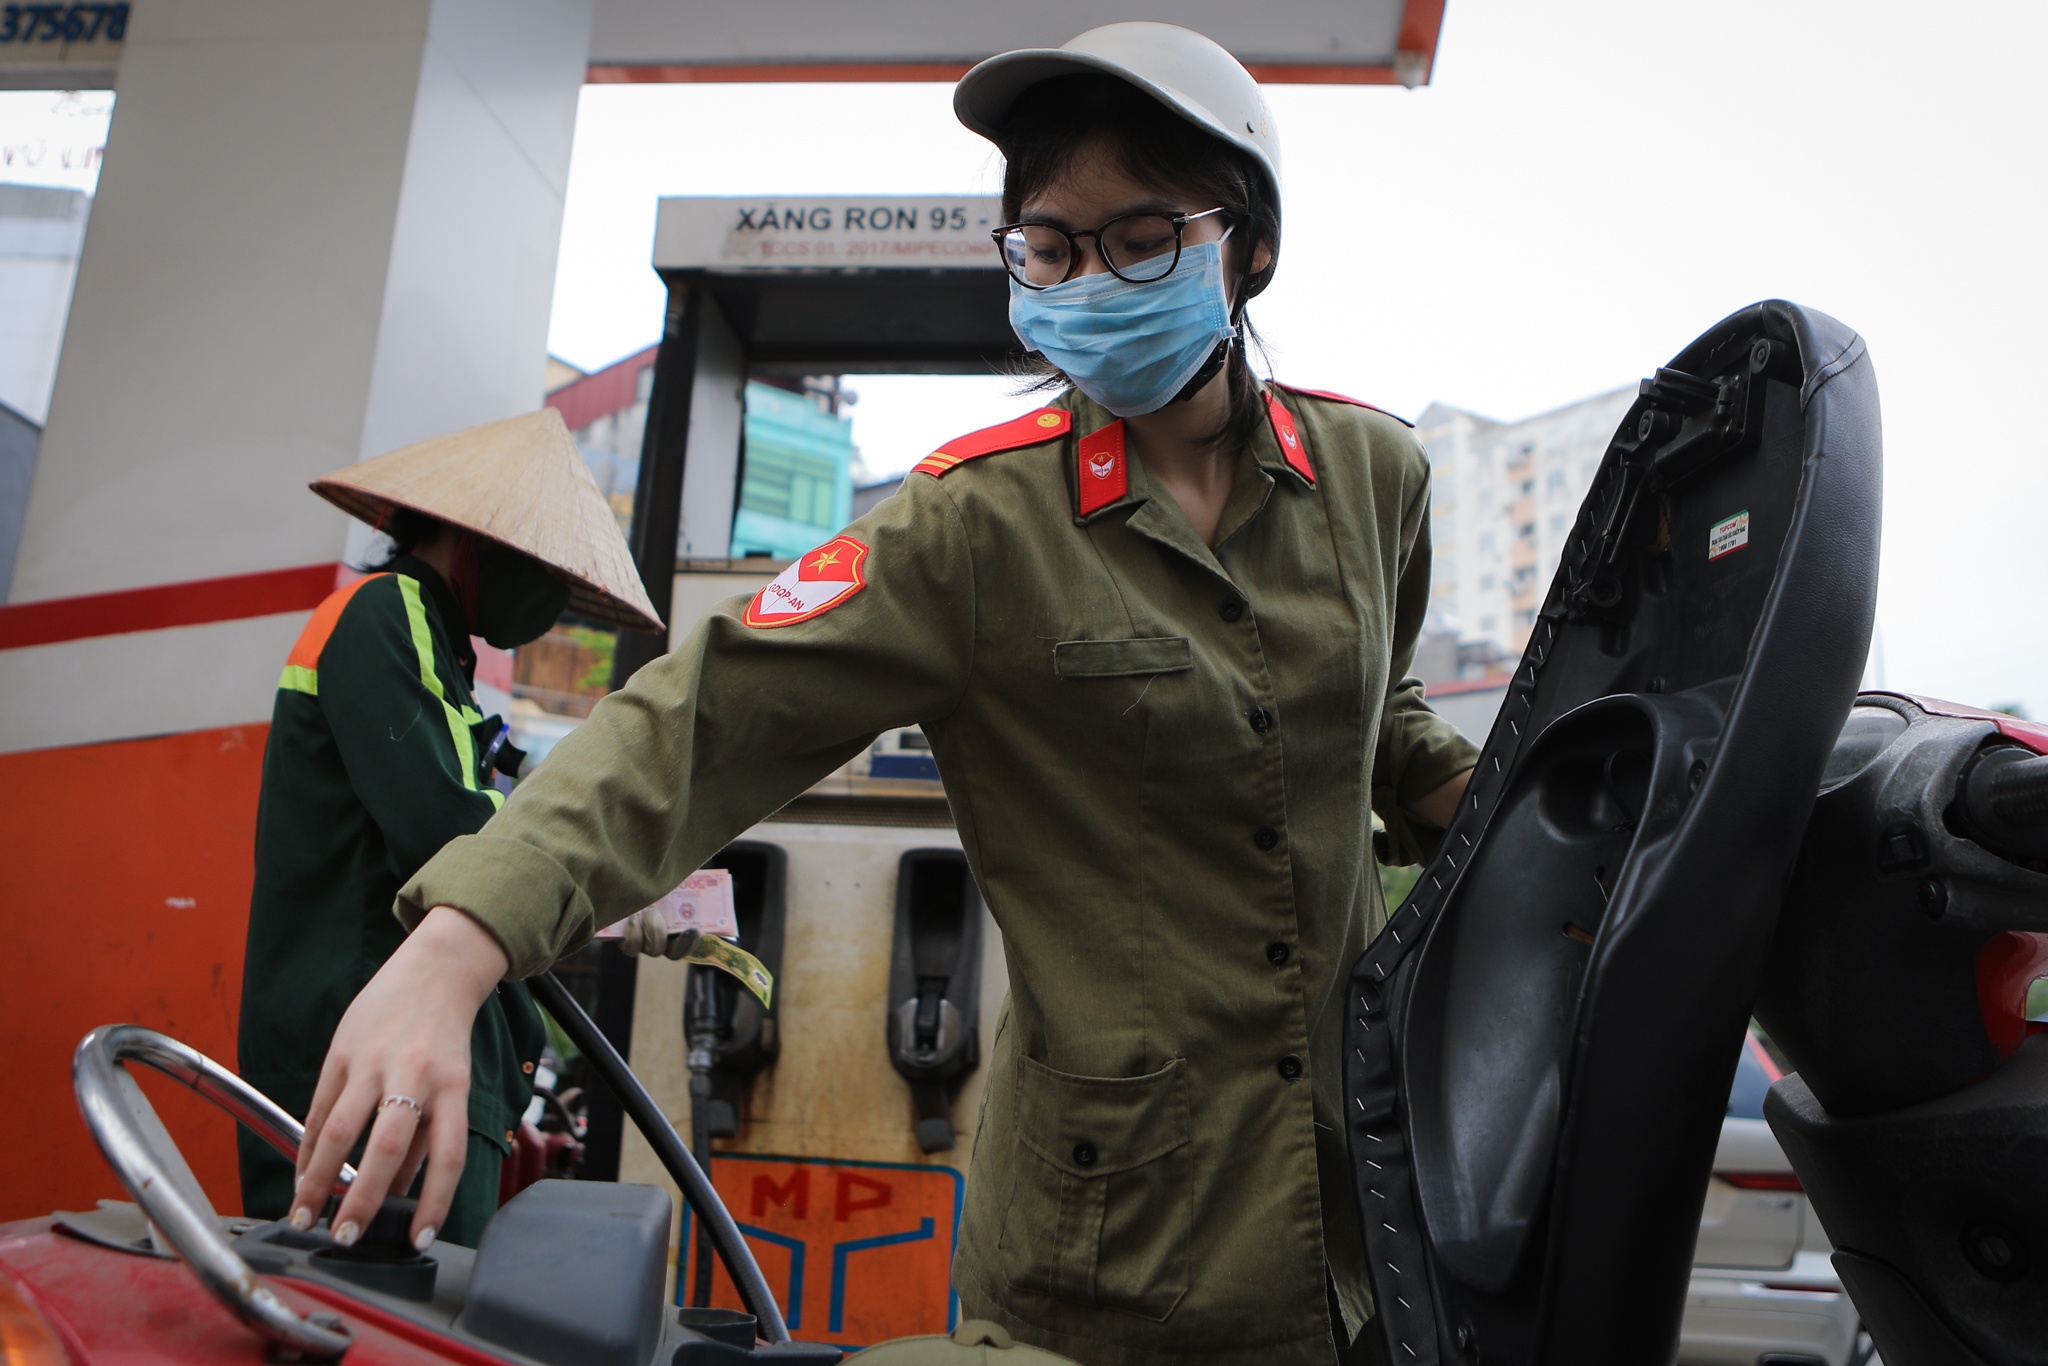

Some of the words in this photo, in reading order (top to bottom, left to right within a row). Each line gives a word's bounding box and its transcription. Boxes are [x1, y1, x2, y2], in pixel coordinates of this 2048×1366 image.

[736, 202, 831, 231] XĂNG
[845, 207, 917, 231] RON
[930, 206, 966, 231] 95
